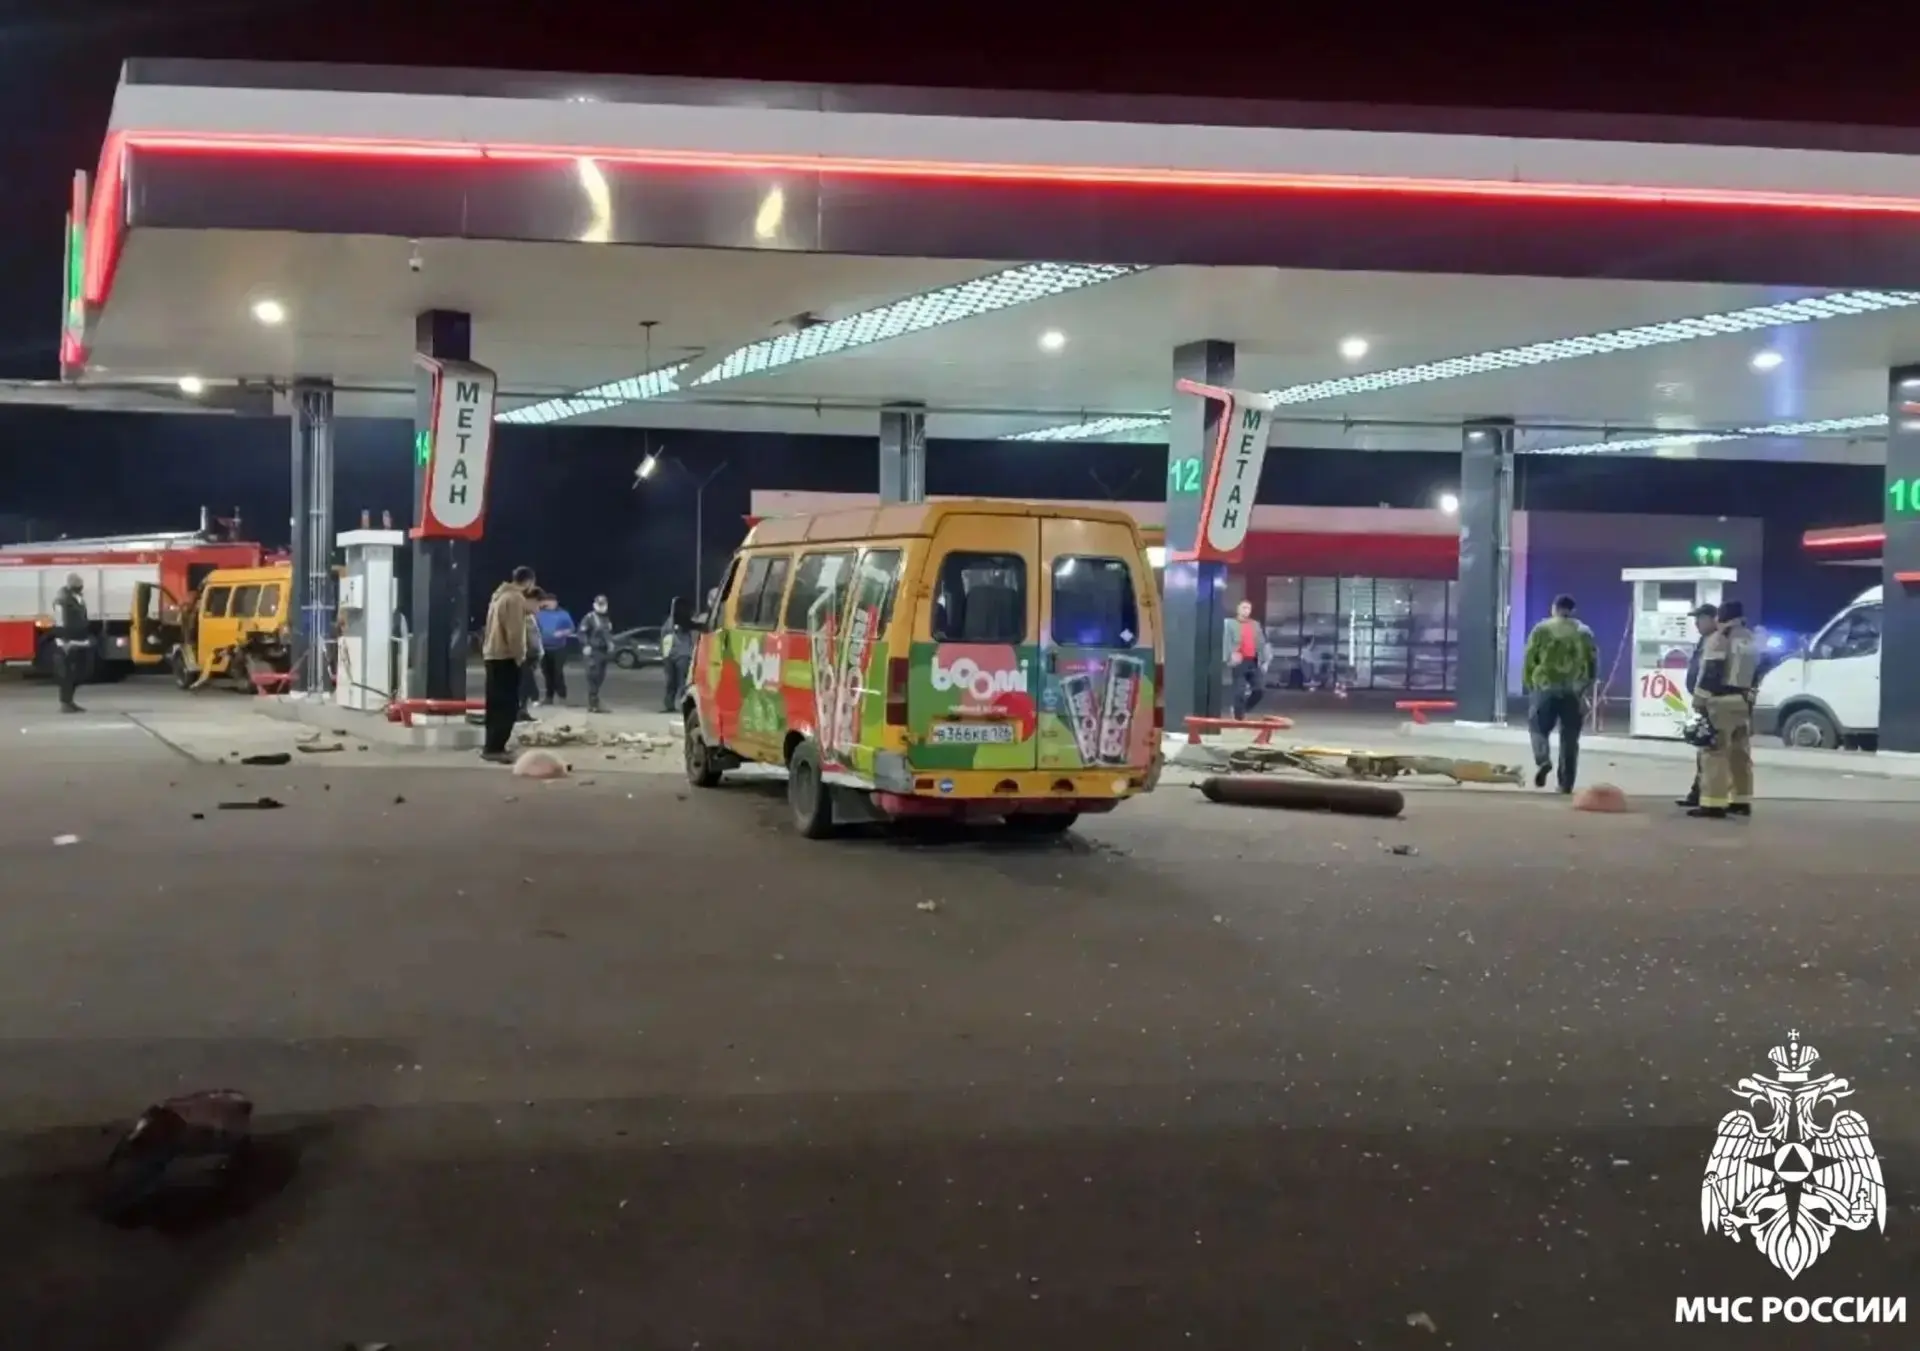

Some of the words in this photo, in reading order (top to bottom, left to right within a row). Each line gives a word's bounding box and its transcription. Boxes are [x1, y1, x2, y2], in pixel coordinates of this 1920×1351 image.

[449, 381, 481, 505] МЕТАН
[1171, 458, 1200, 492] 12
[1222, 408, 1262, 529] МЕТАН
[1640, 674, 1667, 698] 10
